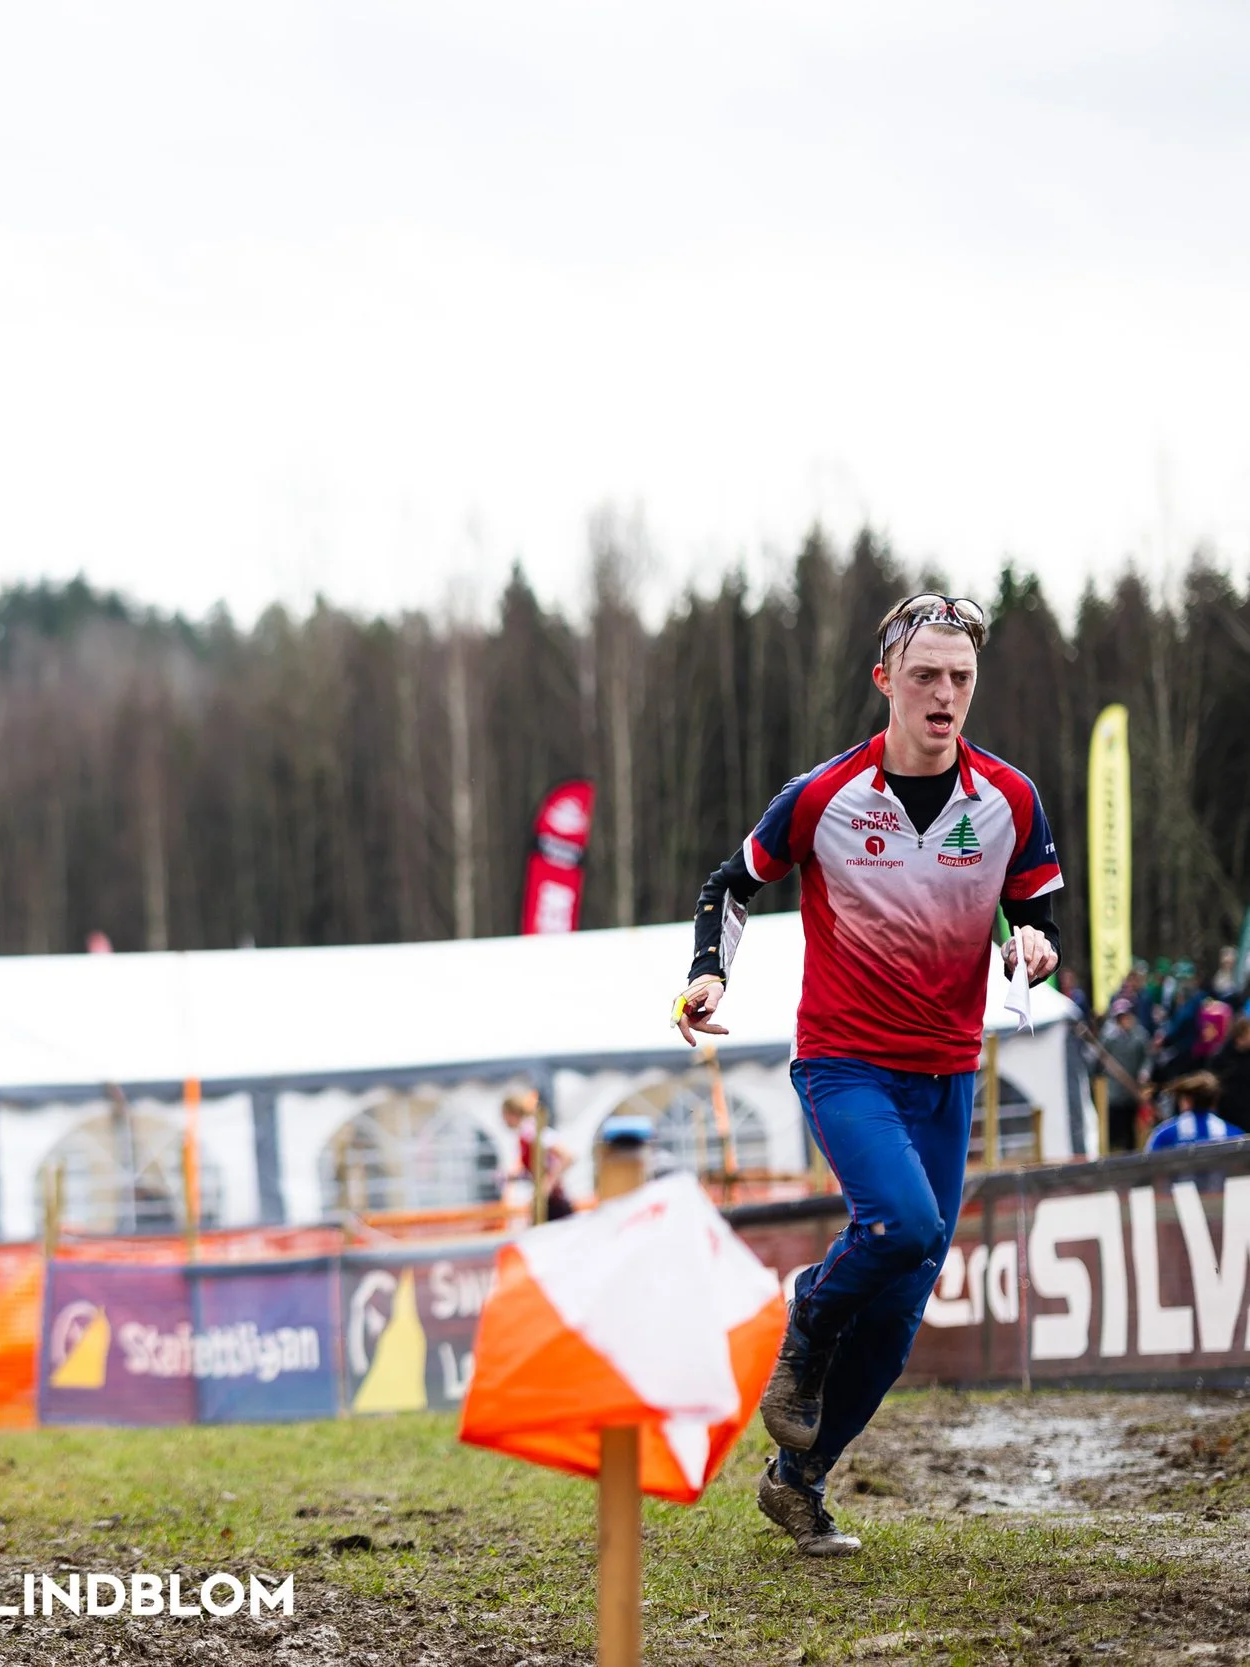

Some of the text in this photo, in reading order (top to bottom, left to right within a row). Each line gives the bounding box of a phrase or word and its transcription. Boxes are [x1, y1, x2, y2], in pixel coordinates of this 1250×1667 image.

[866, 811, 899, 823] TEAM
[846, 857, 904, 869] mäklarringen
[939, 855, 981, 867] JÄRFÄLLA OK
[1030, 1176, 1250, 1360] SILV
[117, 1321, 321, 1384] Stafettligan
